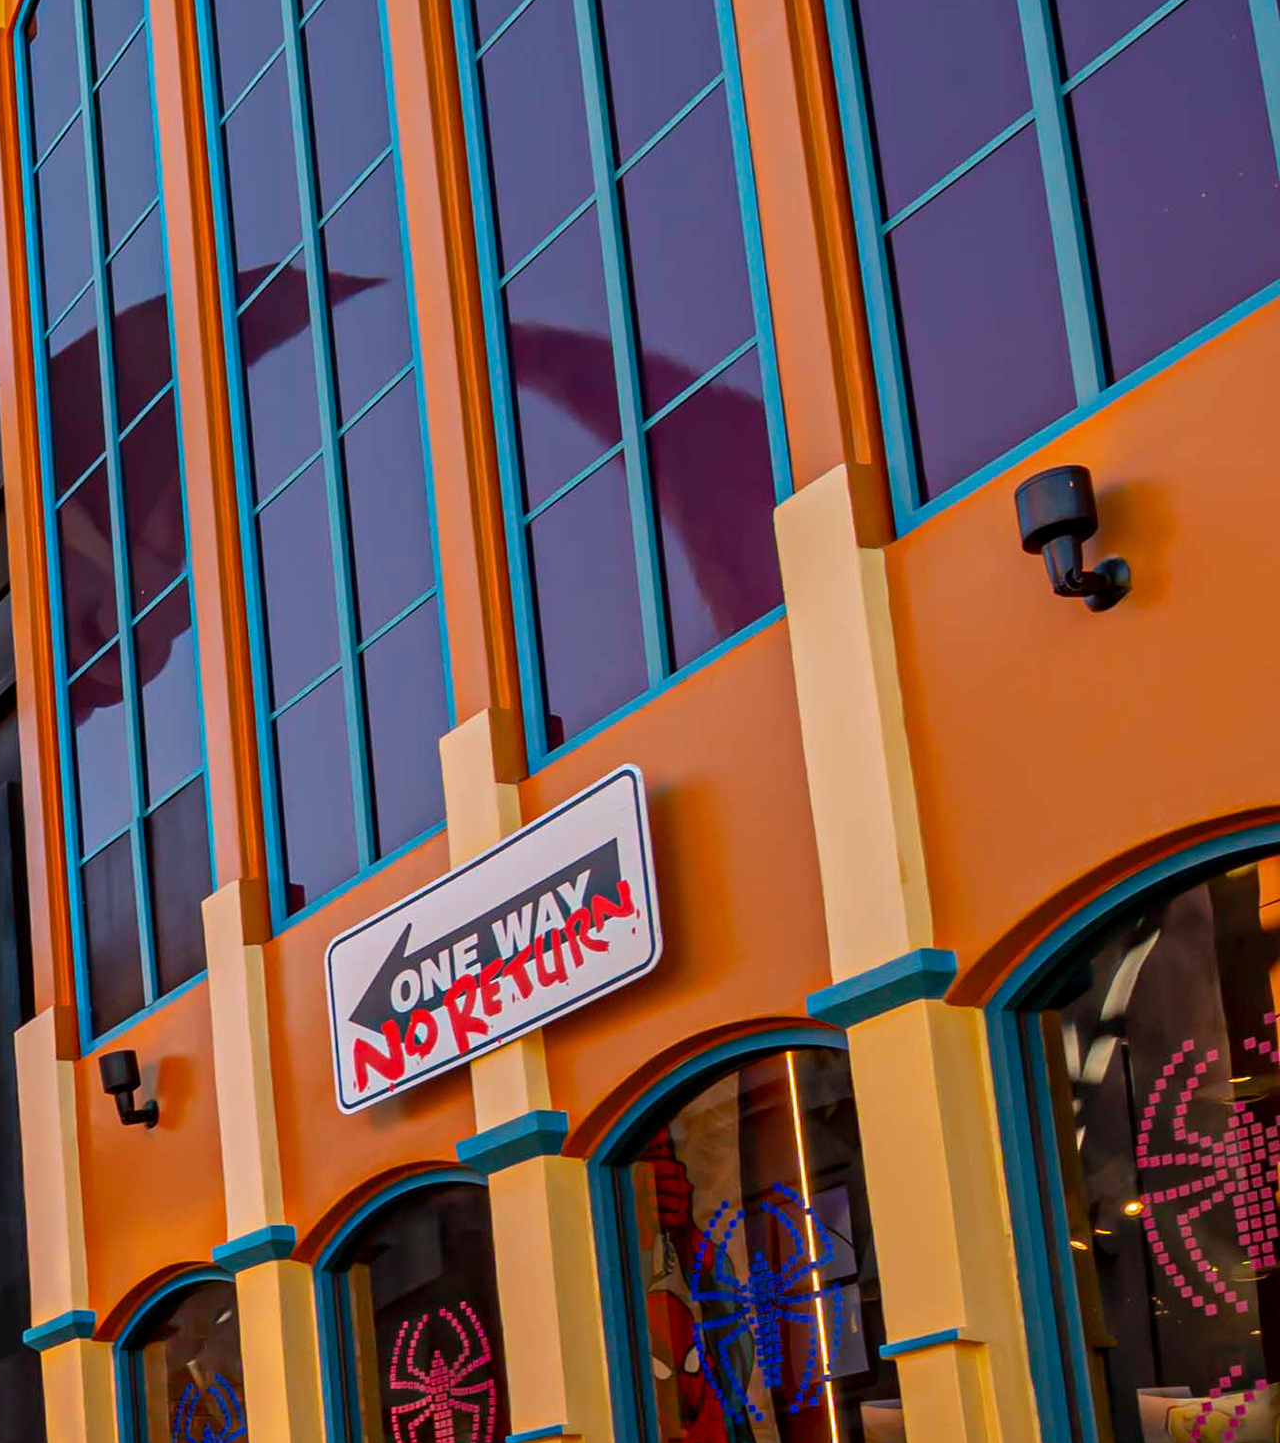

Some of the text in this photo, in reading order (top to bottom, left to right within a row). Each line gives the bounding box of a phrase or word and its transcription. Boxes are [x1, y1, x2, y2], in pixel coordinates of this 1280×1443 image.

[352, 879, 636, 1093] NO RETURN
[390, 869, 591, 1013] ONE WAY
